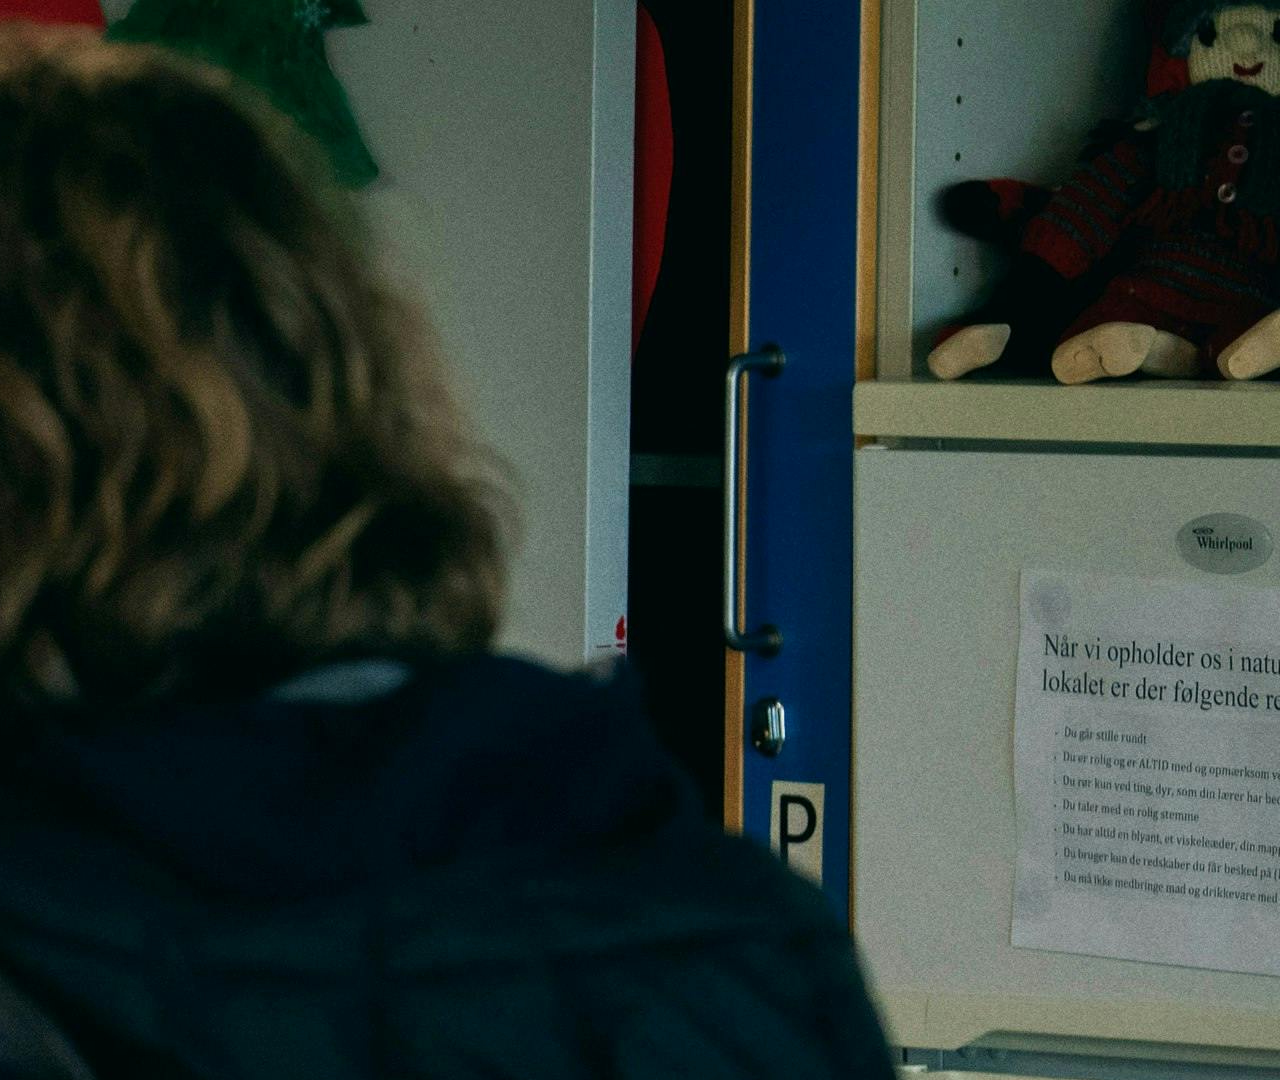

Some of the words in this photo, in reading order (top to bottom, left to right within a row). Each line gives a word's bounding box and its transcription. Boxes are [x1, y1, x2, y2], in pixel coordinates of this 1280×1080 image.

[1197, 536, 1253, 553] Whirlpool
[1044, 633, 1078, 658] Når
[1085, 637, 1101, 660] vi
[1107, 640, 1194, 669] opholder
[1200, 652, 1222, 670] os
[1228, 648, 1233, 670] i
[1043, 668, 1104, 696] lokalet
[1111, 681, 1130, 698] er
[1135, 677, 1167, 701] der
[1174, 679, 1259, 711] følgende
[1064, 726, 1077, 738] Du
[1079, 728, 1093, 741] går
[1096, 729, 1119, 742] stille
[1121, 733, 1147, 745] rundt
[1062, 751, 1076, 762] Du
[1078, 754, 1087, 763] er
[1090, 754, 1112, 768] rolig
[1113, 759, 1125, 769] og
[1126, 759, 1136, 768] er
[1138, 758, 1169, 771] ALTID
[1171, 761, 1192, 773] med
[1194, 765, 1207, 777] og
[1209, 766, 1269, 780] opmærksom
[1062, 775, 1075, 786] Du
[1094, 778, 1112, 790] kun
[1114, 781, 1131, 791] ved
[1155, 783, 1175, 798] dyr,
[1177, 787, 1197, 798] som
[1199, 786, 1215, 799] din
[1218, 788, 1244, 802] lærer
[1247, 790, 1263, 803] har
[1062, 799, 1075, 810] Du
[1077, 801, 1098, 812] taler
[1101, 803, 1121, 815] med
[1123, 807, 1135, 816] en
[1137, 807, 1158, 821] rolig
[1160, 810, 1200, 822] stemme
[779, 794, 817, 862] P
[1062, 822, 1075, 834] Du
[1077, 824, 1092, 836] har
[1095, 826, 1116, 839] altid
[1117, 831, 1129, 840] en
[1164, 834, 1174, 844] et
[1239, 839, 1256, 852] din
[1063, 847, 1076, 858] Du
[1078, 848, 1108, 864] bruger
[1110, 851, 1128, 864] kun
[1129, 853, 1141, 865] de
[1143, 856, 1190, 871] redskaber
[1192, 860, 1205, 872] du
[1207, 861, 1221, 873] får
[1224, 863, 1258, 877] besked
[1260, 867, 1271, 881] på
[1063, 870, 1076, 883] Du
[1078, 873, 1092, 884] må
[1094, 874, 1113, 887] ikke
[1115, 878, 1164, 894] medbringe
[1166, 883, 1186, 895] mad
[1188, 887, 1200, 898] og
[1202, 886, 1256, 901] drikkevare
[1258, 893, 1278, 904] med
